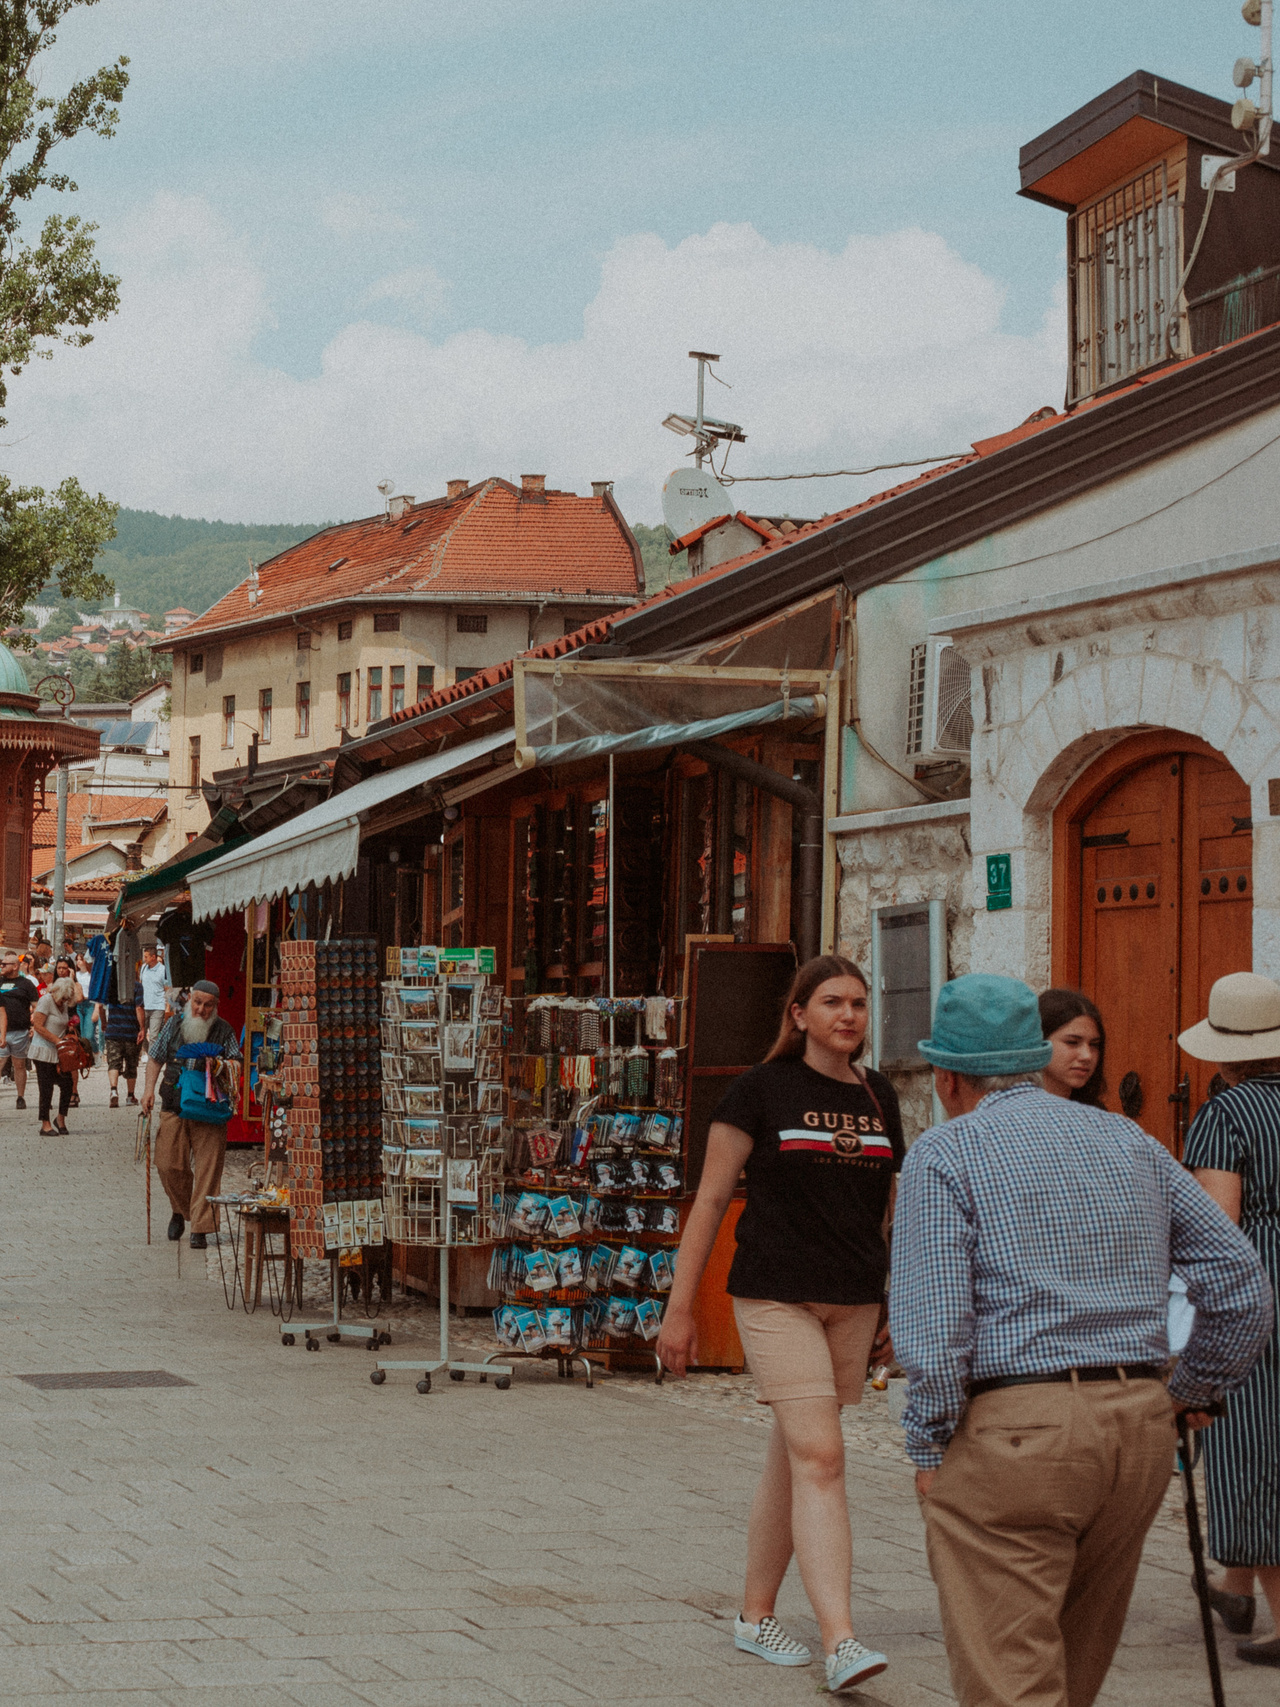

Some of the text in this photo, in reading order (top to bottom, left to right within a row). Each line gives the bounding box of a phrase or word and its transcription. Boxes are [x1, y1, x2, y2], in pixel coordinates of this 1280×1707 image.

[990, 863, 1007, 886] 37
[803, 1111, 883, 1132] GUESS
[837, 1157, 881, 1169] ANGELES
